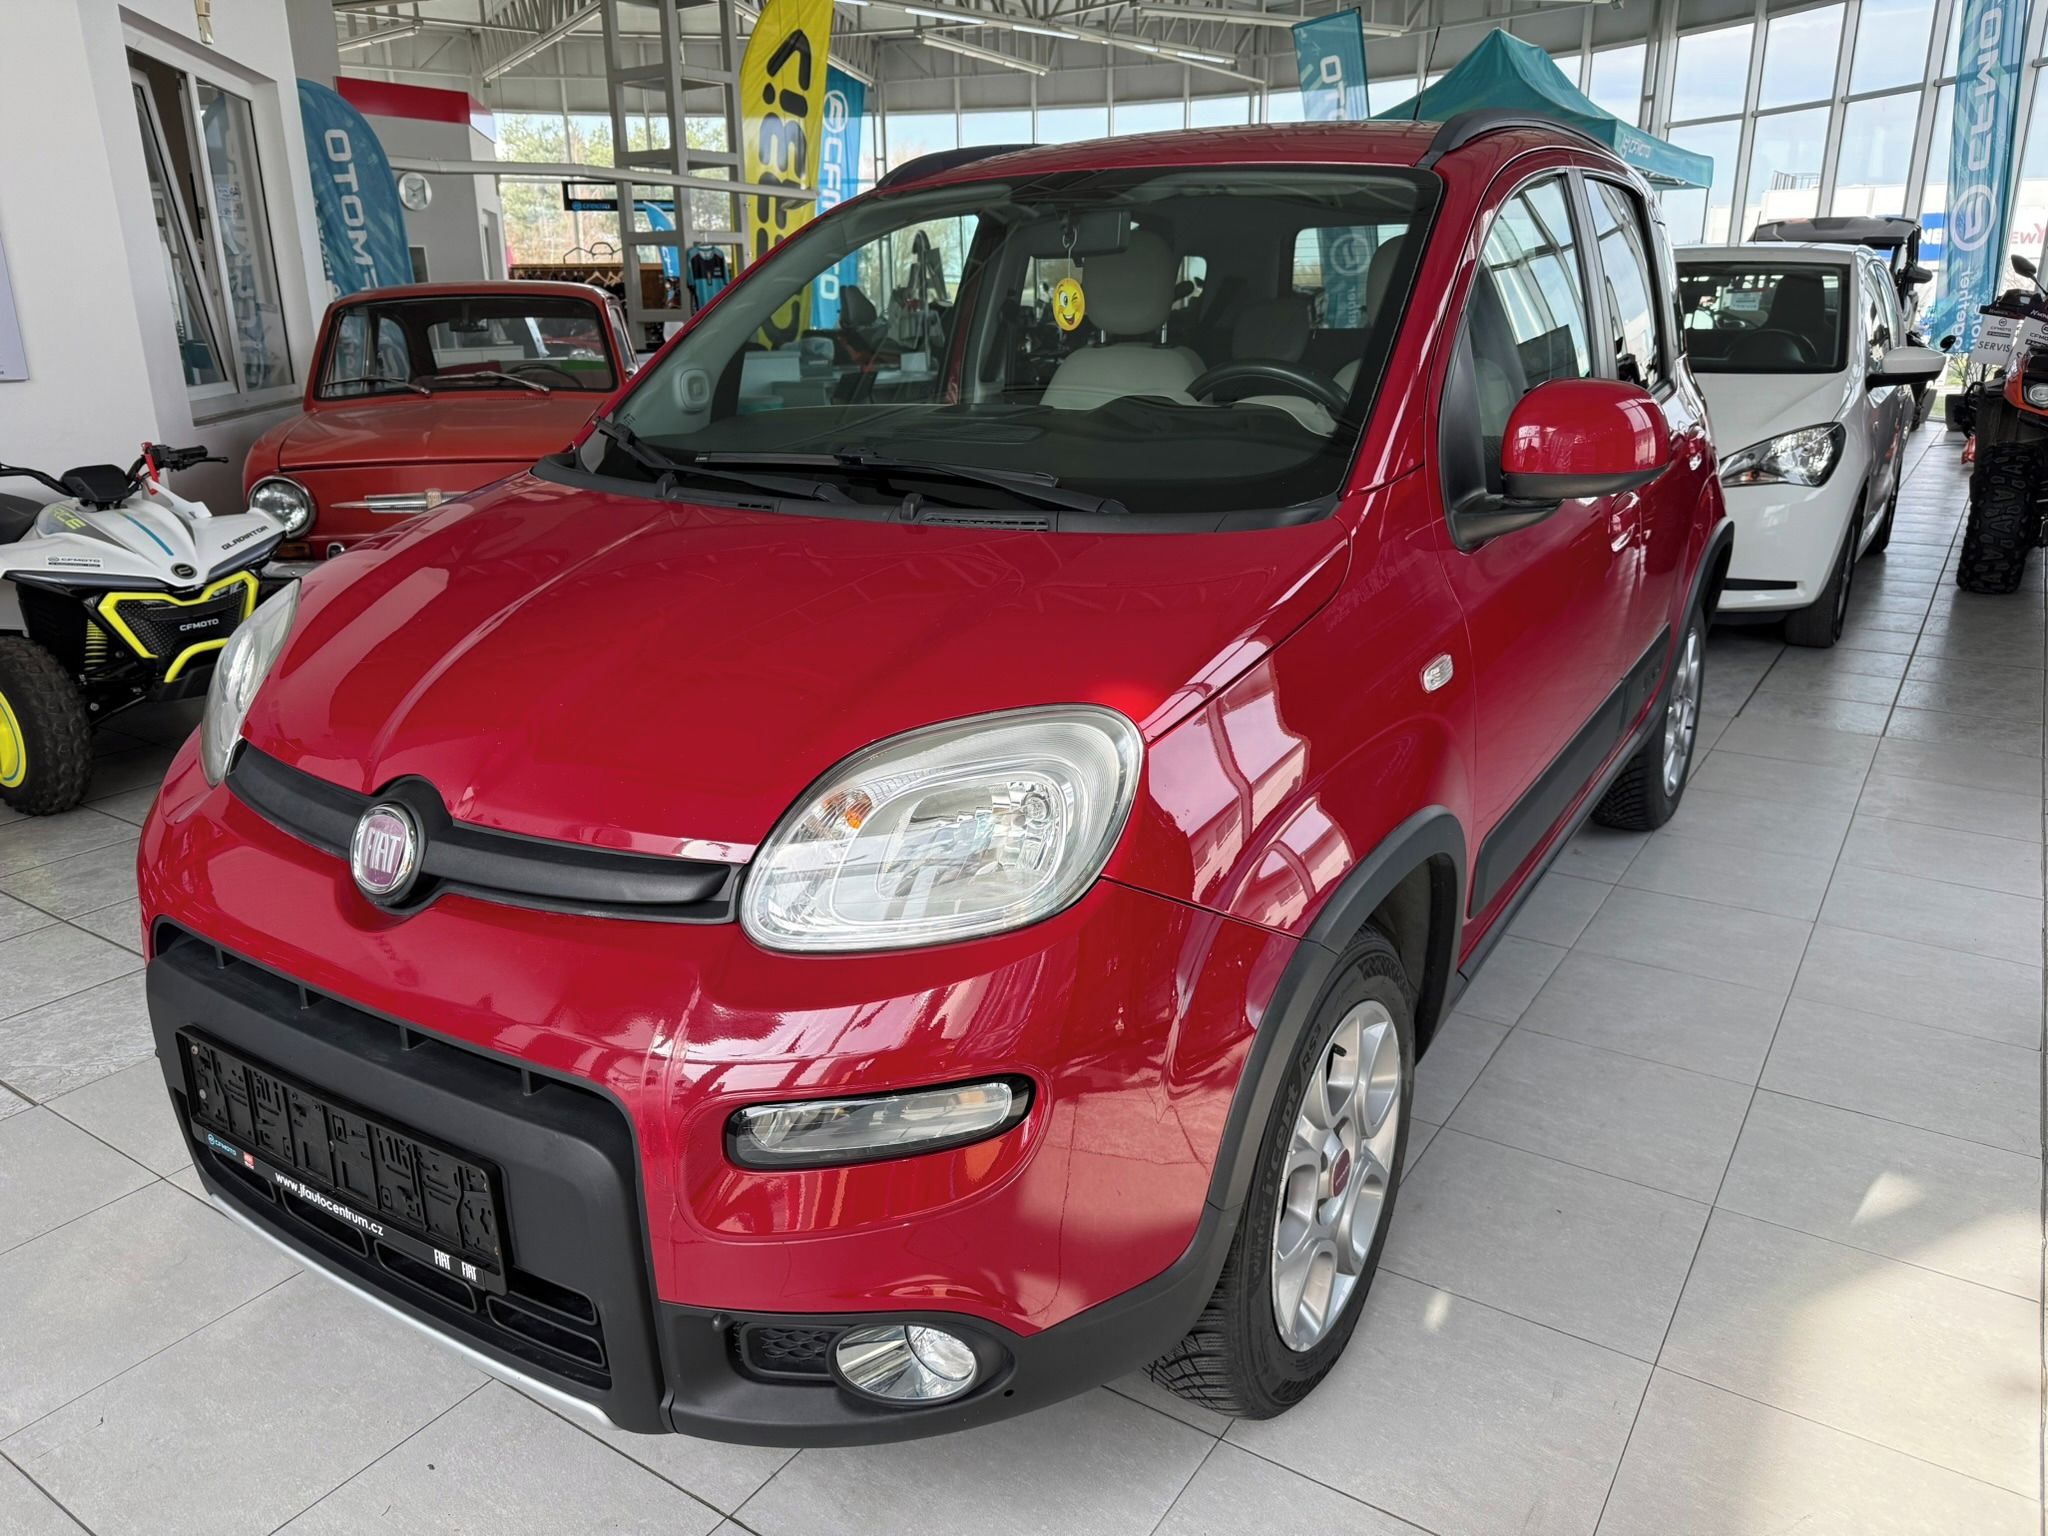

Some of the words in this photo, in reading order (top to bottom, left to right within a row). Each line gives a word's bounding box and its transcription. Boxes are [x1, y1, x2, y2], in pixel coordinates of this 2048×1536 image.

[1977, 340, 2011, 353] SERVIS
[221, 525, 270, 551] GLADIATOR
[179, 618, 219, 632] CFMOTO
[363, 827, 401, 874] FIAT
[275, 1172, 384, 1236] www.jfautocentrum.cz
[434, 1249, 451, 1271] FIAT
[461, 1261, 477, 1281] FIAT
